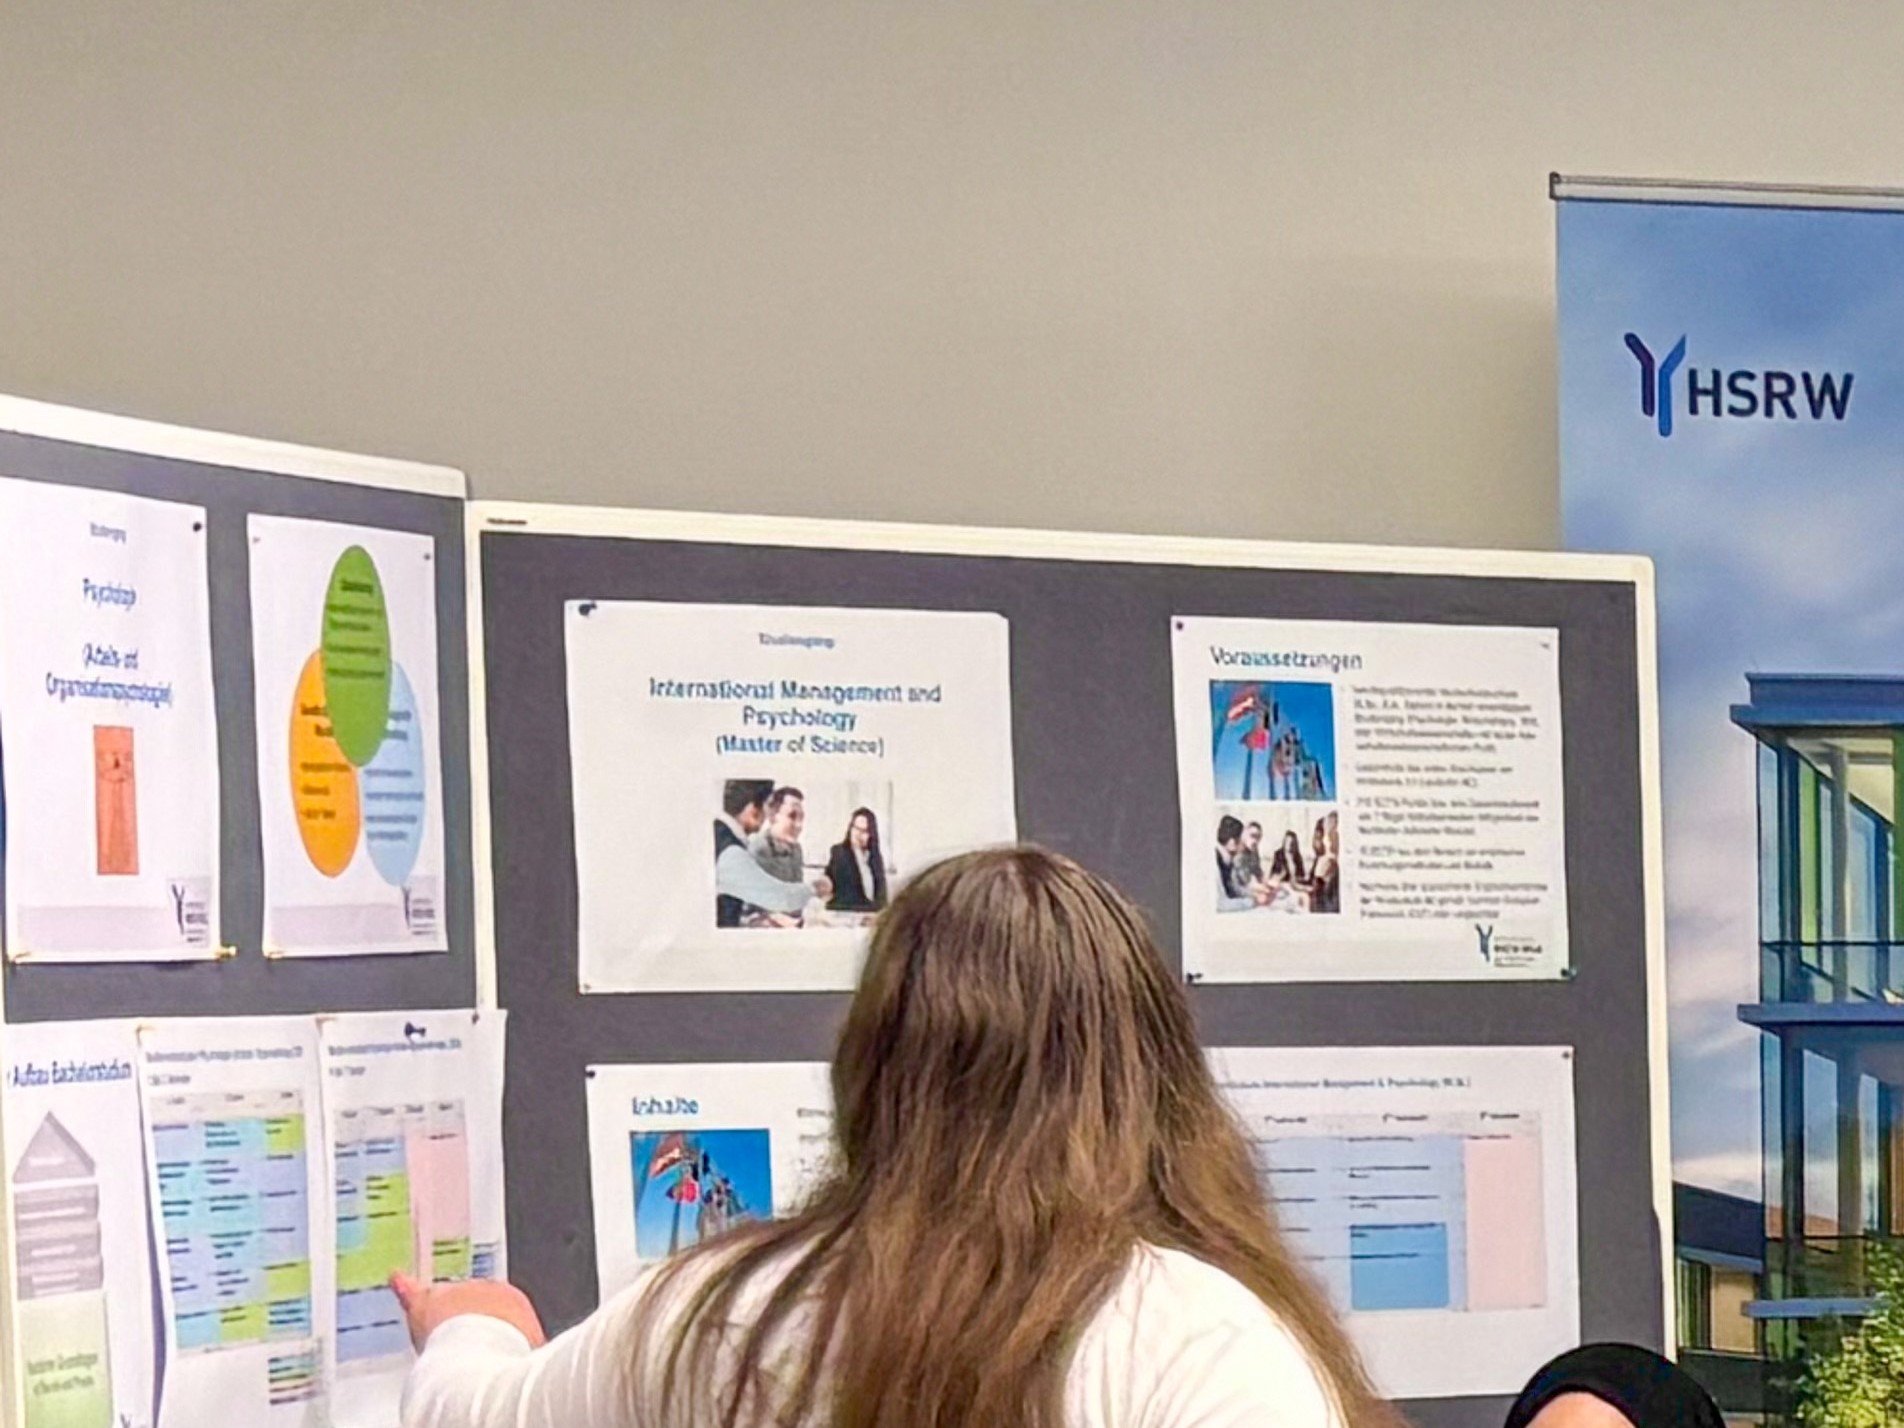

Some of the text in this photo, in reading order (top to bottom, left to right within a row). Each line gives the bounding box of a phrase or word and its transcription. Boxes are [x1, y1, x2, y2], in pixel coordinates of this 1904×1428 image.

[1688, 367, 1854, 421] HSRW
[1210, 647, 1363, 673] Voraussetzungen
[650, 677, 942, 705] International Management and
[743, 705, 857, 732] Psychology
[716, 735, 783, 757] (Master
[786, 736, 806, 754] of
